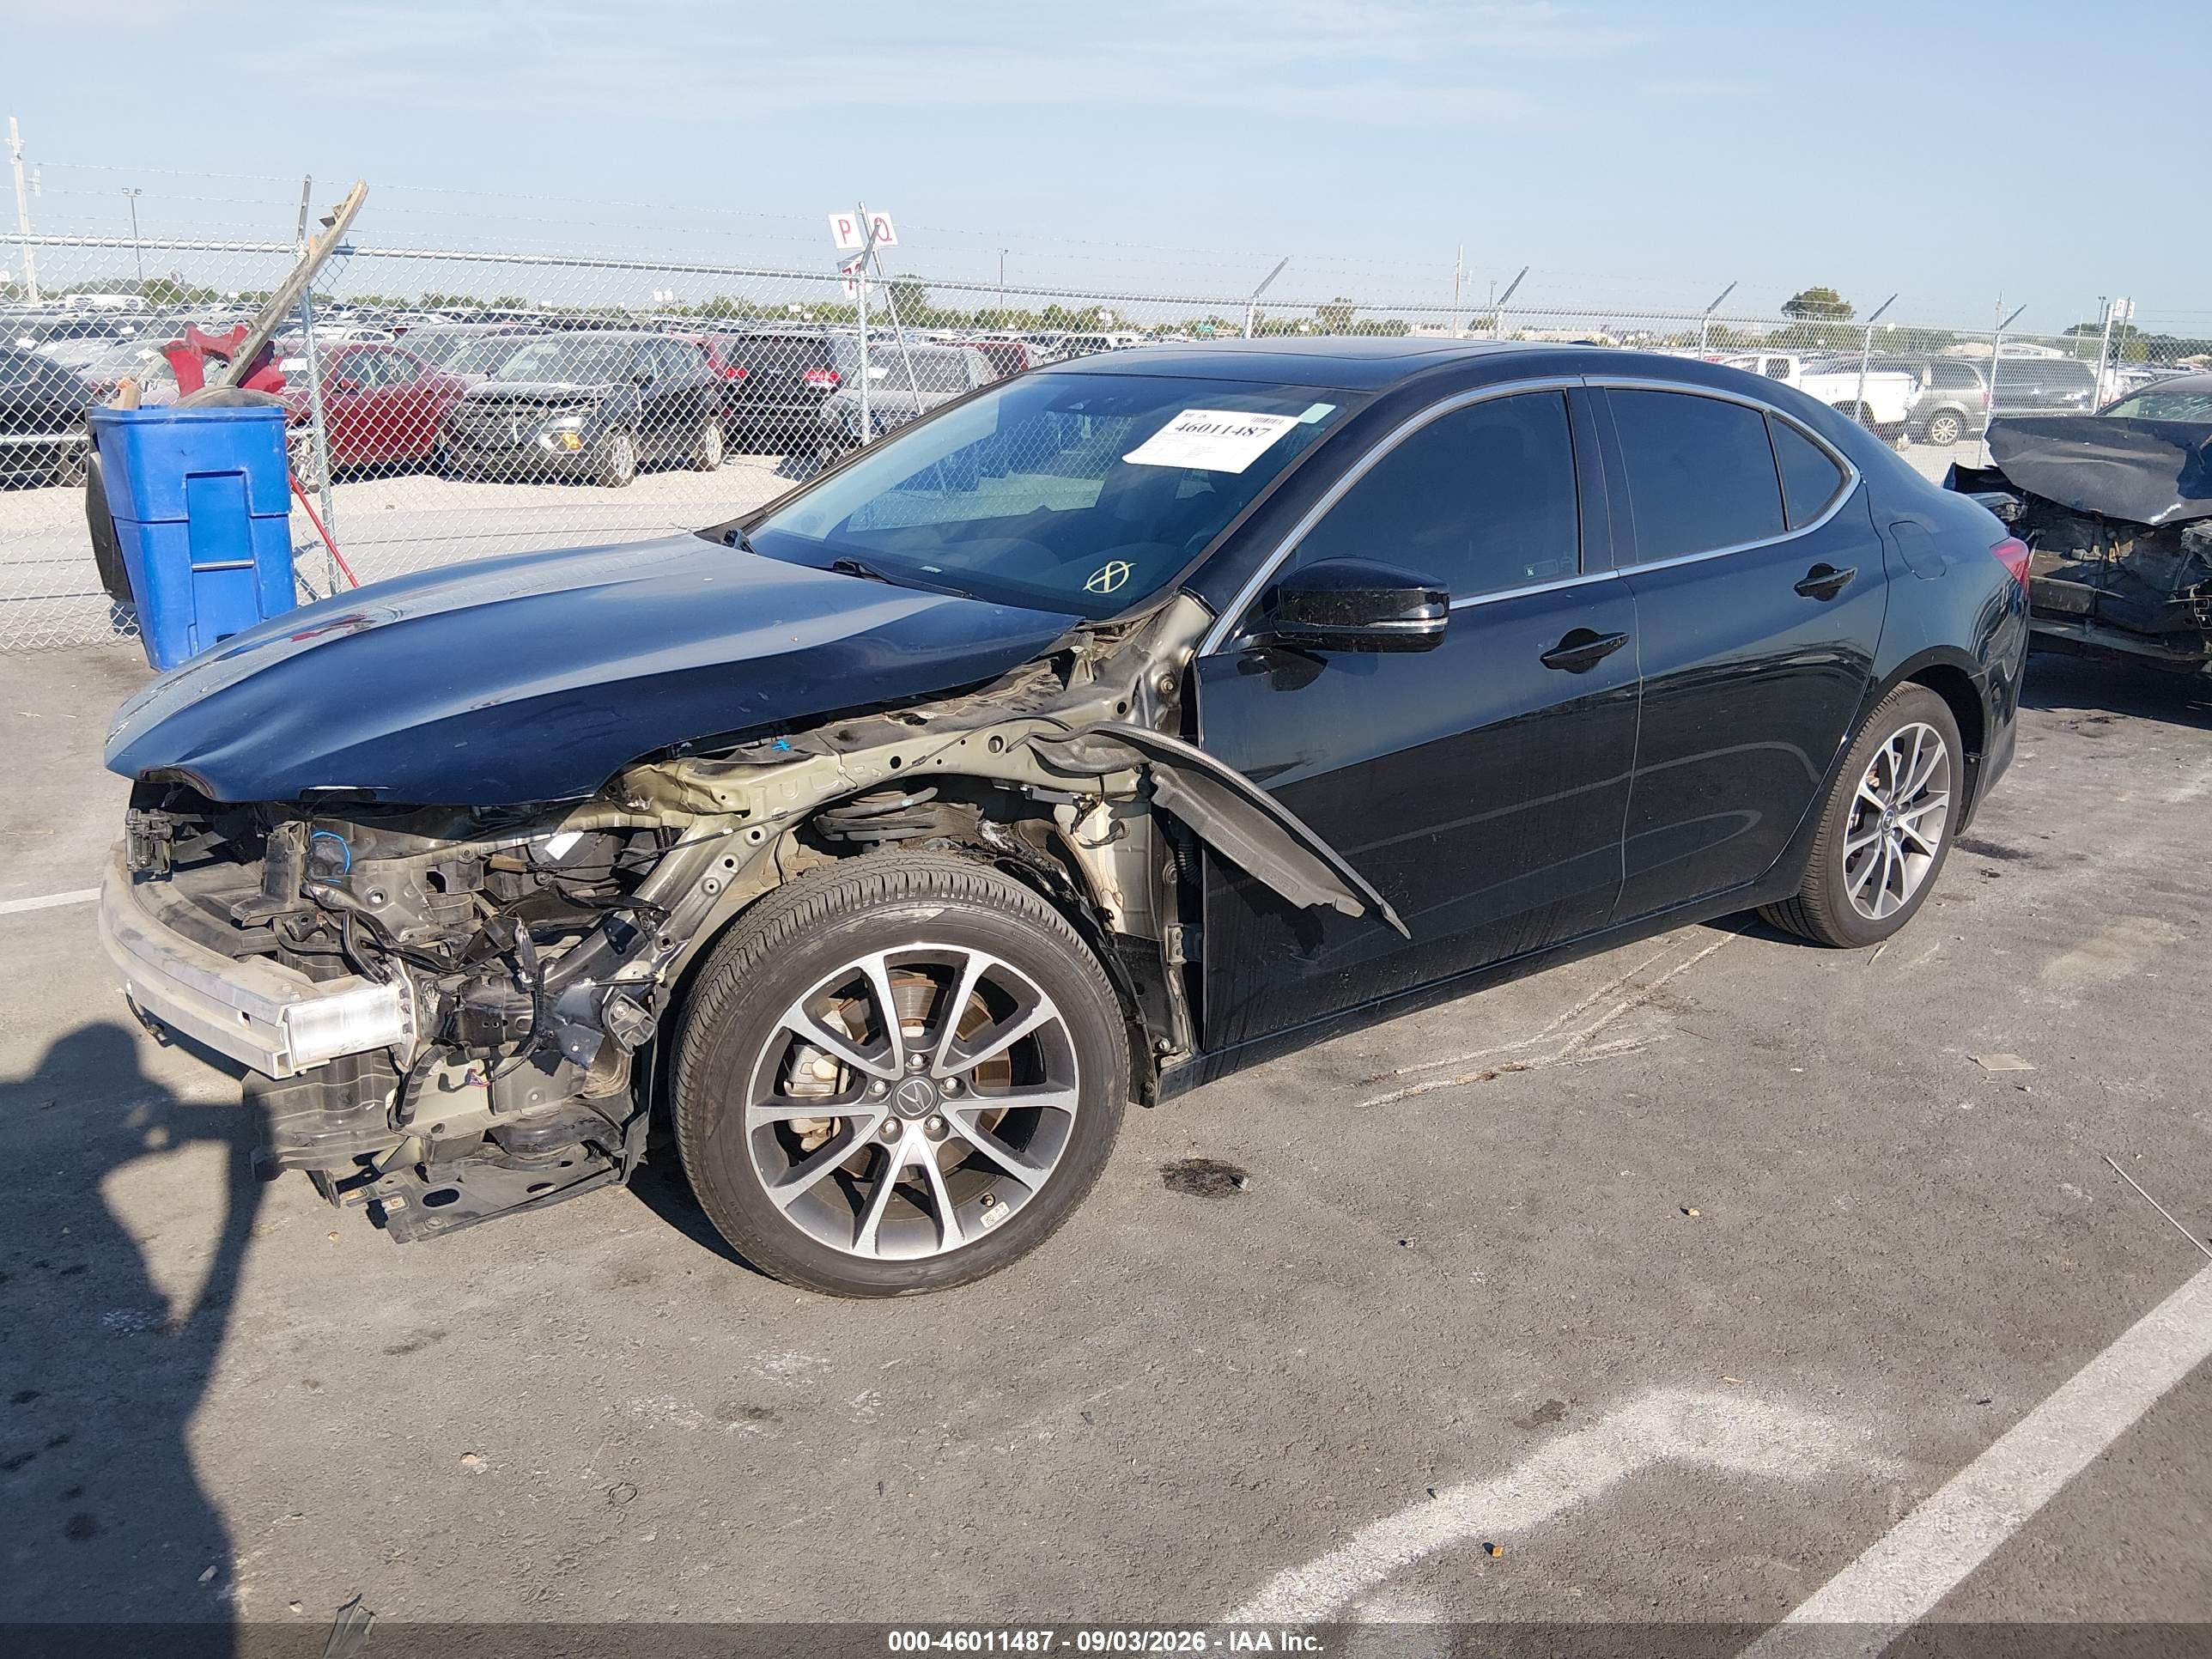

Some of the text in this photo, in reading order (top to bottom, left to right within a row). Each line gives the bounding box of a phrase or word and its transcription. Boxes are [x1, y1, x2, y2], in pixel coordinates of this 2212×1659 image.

[837, 219, 851, 245] P
[873, 217, 893, 242] Q
[1175, 421, 1273, 438] 46011487
